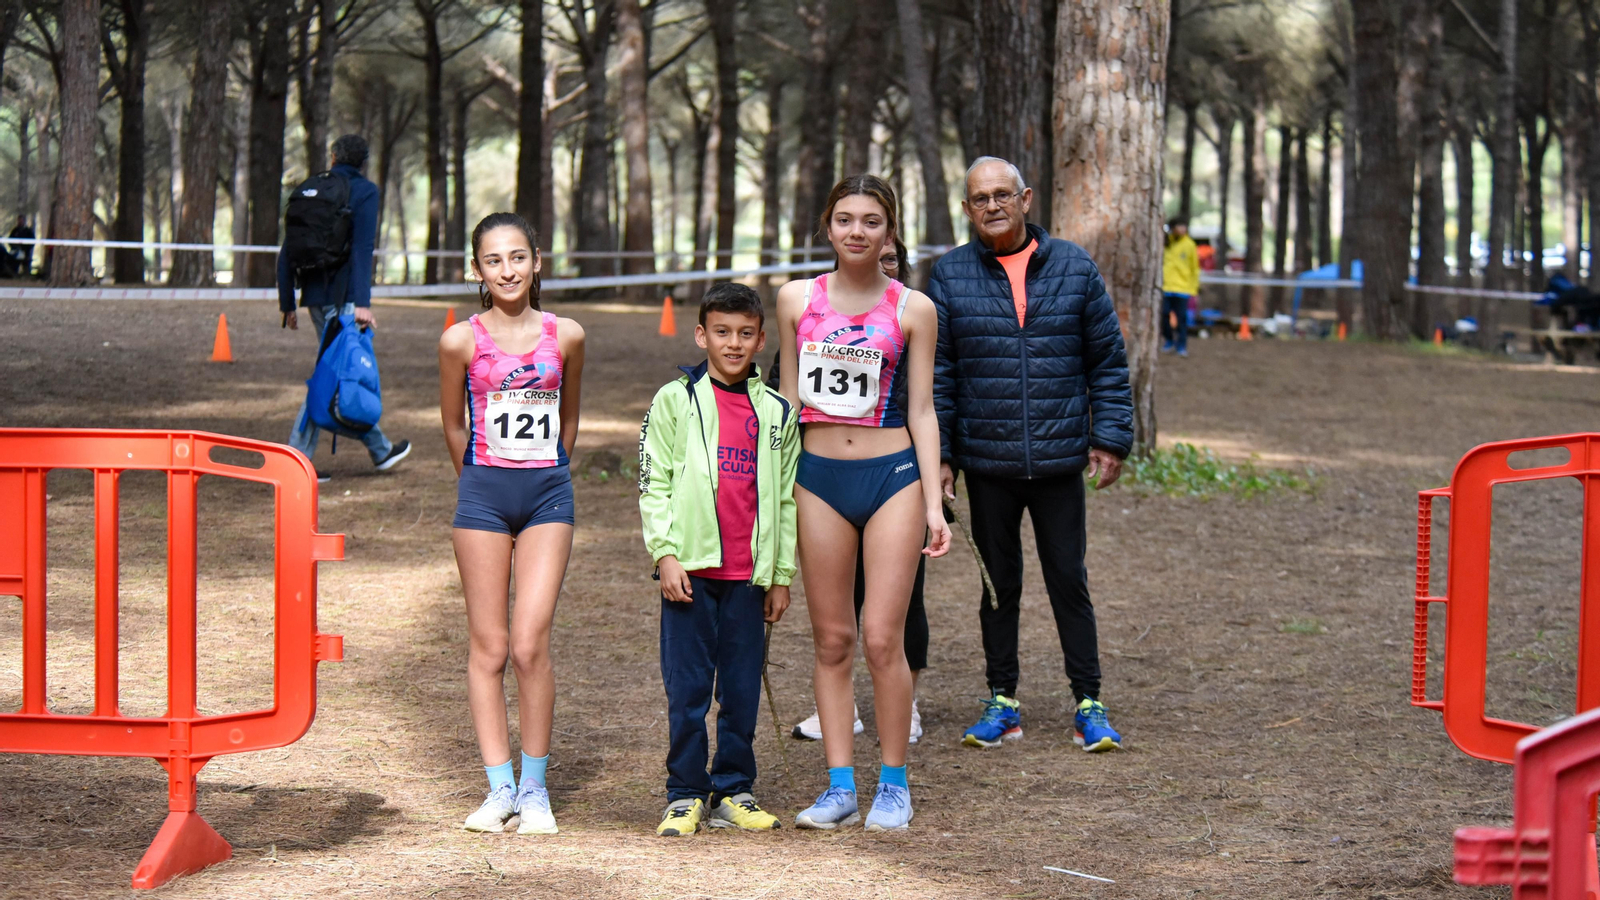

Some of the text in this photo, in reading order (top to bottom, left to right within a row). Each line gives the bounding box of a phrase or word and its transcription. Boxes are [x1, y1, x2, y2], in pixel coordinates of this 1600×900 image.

[825, 326, 852, 344] IRAS
[821, 353, 846, 361] PINAR
[846, 356, 861, 364] DEL
[863, 358, 880, 366] REY
[807, 366, 868, 398] 131
[493, 412, 551, 439] 121
